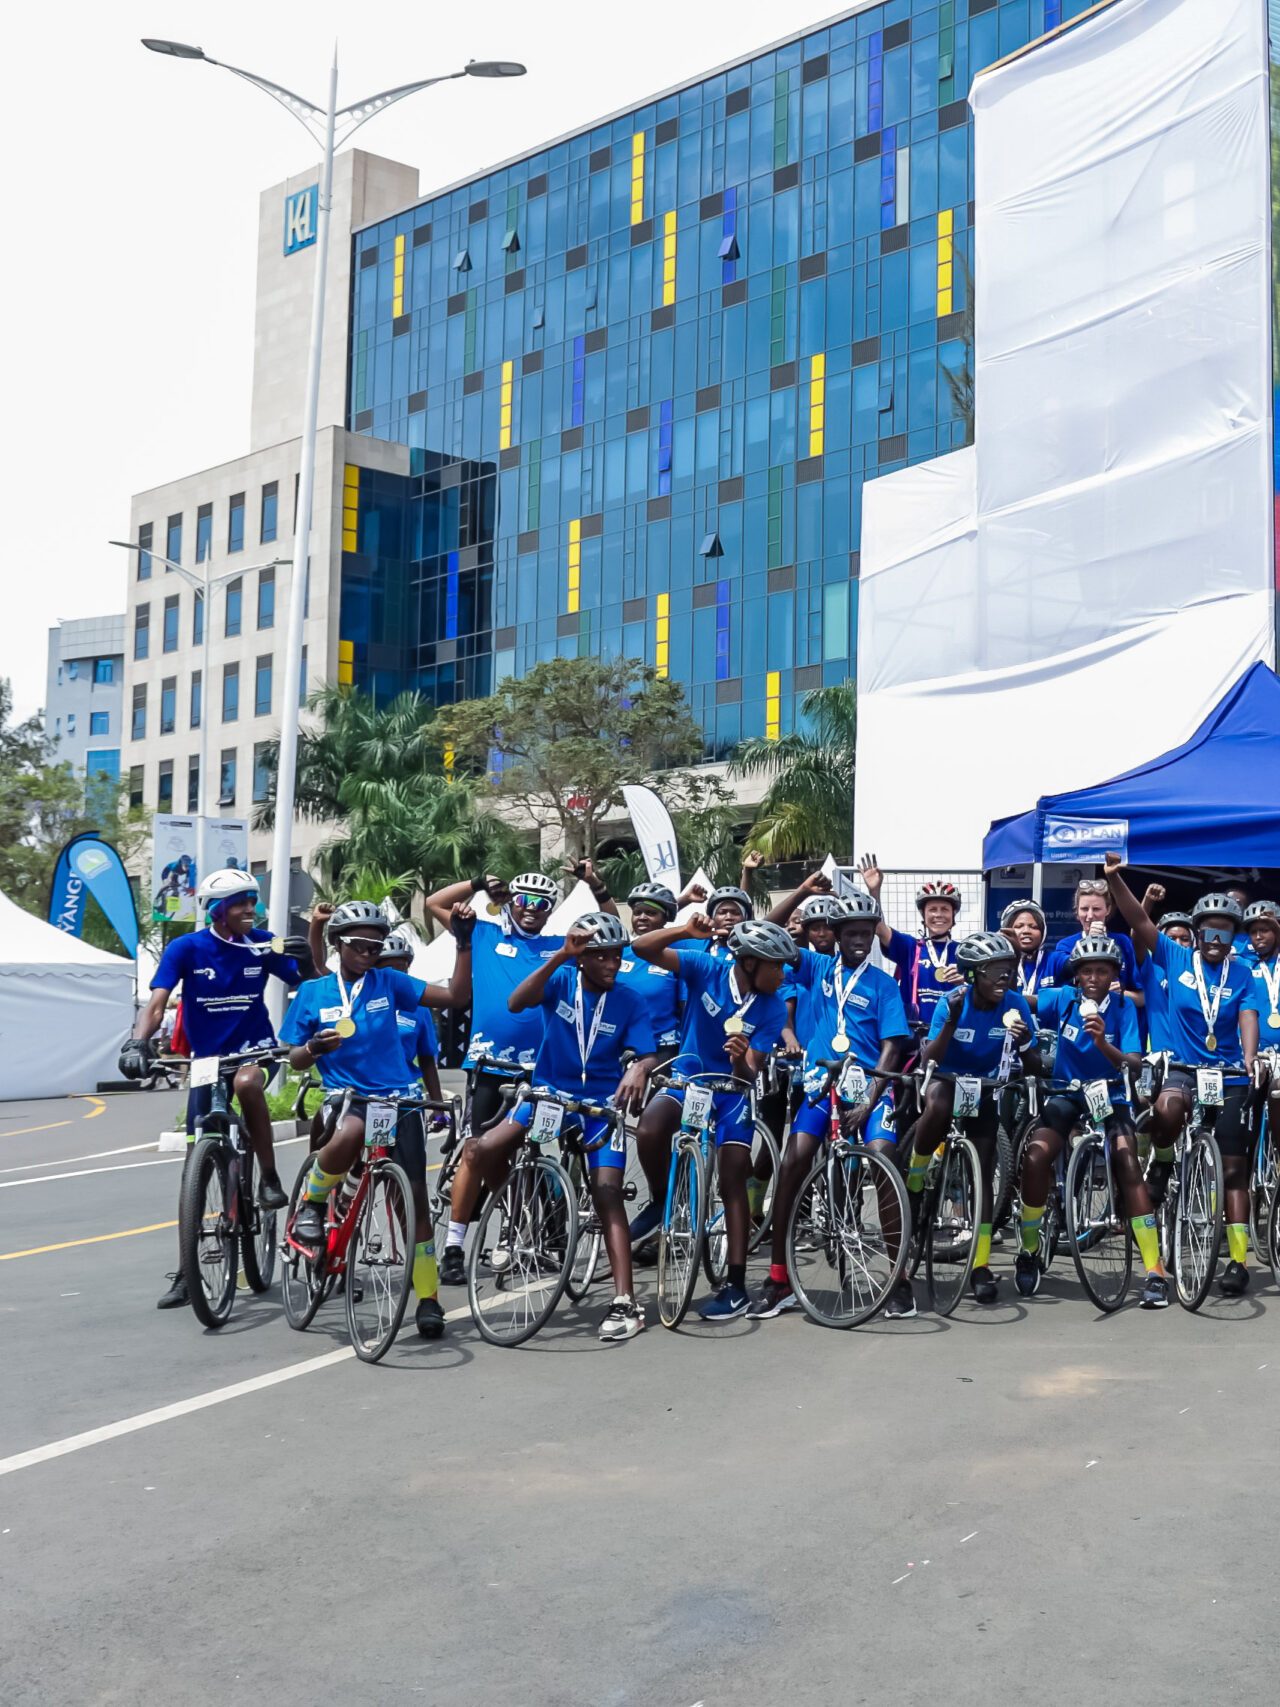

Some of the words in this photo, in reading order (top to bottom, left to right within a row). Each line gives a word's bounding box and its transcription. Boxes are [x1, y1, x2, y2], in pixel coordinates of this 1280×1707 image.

[1080, 828, 1121, 839] PLAN
[851, 1079, 863, 1089] 172
[1092, 1095, 1105, 1105] 174
[691, 1101, 705, 1111] 167
[372, 1118, 390, 1129] 647
[541, 1116, 556, 1127] 157
